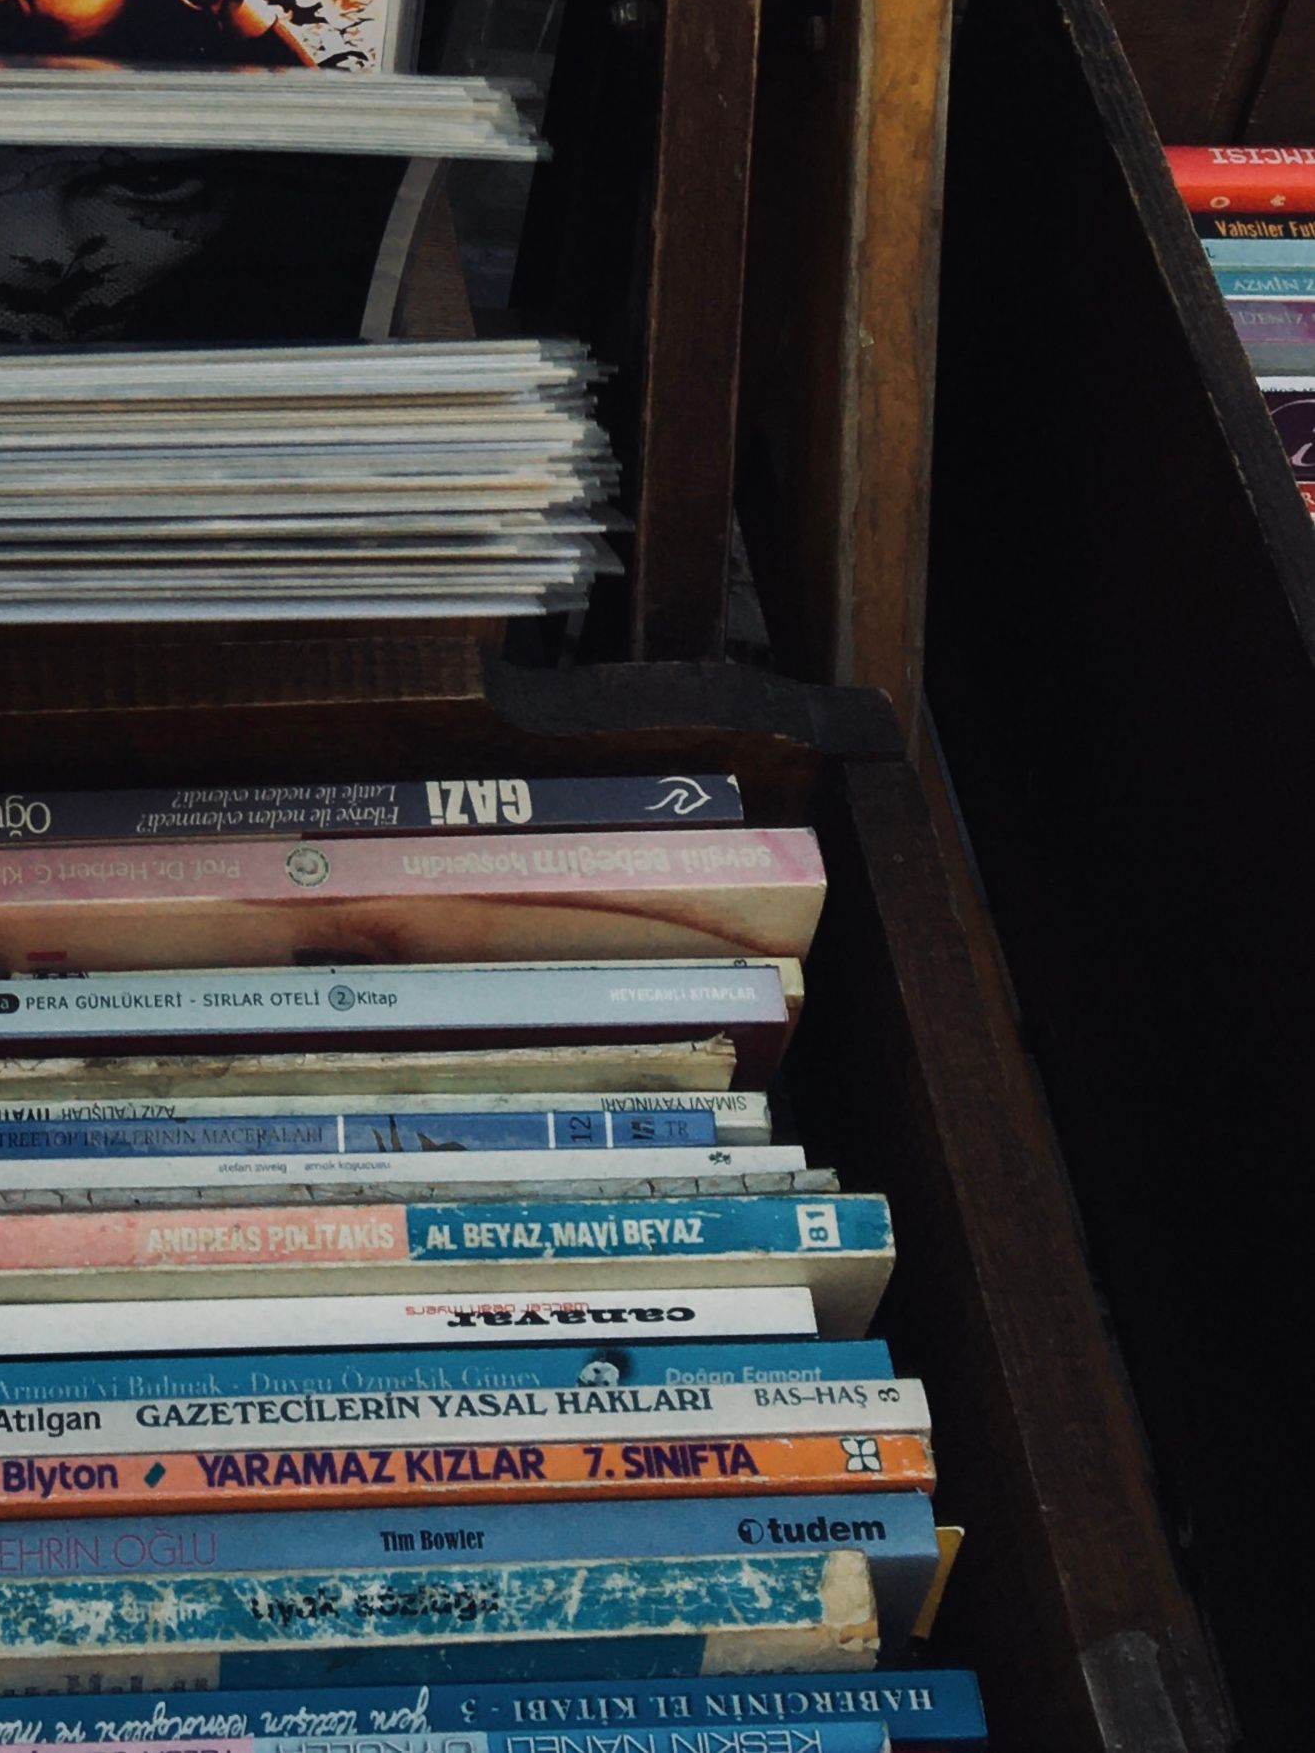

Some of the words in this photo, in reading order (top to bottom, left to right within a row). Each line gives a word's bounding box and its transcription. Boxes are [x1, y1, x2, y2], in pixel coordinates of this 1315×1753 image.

[171, 790, 248, 808] evlendi?
[254, 788, 312, 806] neden
[317, 788, 337, 805] ile
[427, 779, 532, 825] GAZİ
[137, 812, 243, 832] evlenmedi?
[248, 811, 306, 829] neden
[310, 810, 331, 827] ile
[30, 862, 52, 881] G.
[59, 860, 149, 881] Herbert
[152, 859, 185, 879] Dr.
[191, 858, 241, 879] Prof.
[26, 996, 69, 1010] PERA
[76, 991, 183, 1010] GÜNLÜKLERİ
[203, 992, 263, 1008] SIRLAR
[270, 989, 320, 1007] OTELİ
[357, 990, 397, 1007] Kitap
[147, 1227, 261, 1252] ANDREAS
[427, 1225, 457, 1250] AL
[552, 1215, 618, 1247] MAVİ
[623, 1218, 704, 1245] BEYAZ
[447, 1305, 695, 1327] canavar
[136, 1390, 420, 1427] GAZETECİLERİN
[431, 1393, 547, 1417] YASAL
[558, 1388, 712, 1414] HAKLARI
[2, 1460, 119, 1498] Blyton
[197, 1449, 395, 1488] YARAMAZ
[405, 1447, 547, 1482] KIZLAR
[583, 1447, 615, 1479] 7.
[624, 1443, 759, 1479] SINIFTA
[380, 1530, 415, 1552] Tim
[420, 1528, 484, 1551] Bowler
[768, 1518, 886, 1544] tudem
[113, 1528, 219, 1567] OĞLU
[460, 1700, 477, 1724] 3
[512, 1695, 637, 1723] KİTABI
[650, 1697, 692, 1721] EL
[707, 1687, 933, 1724] HABERCİNİN
